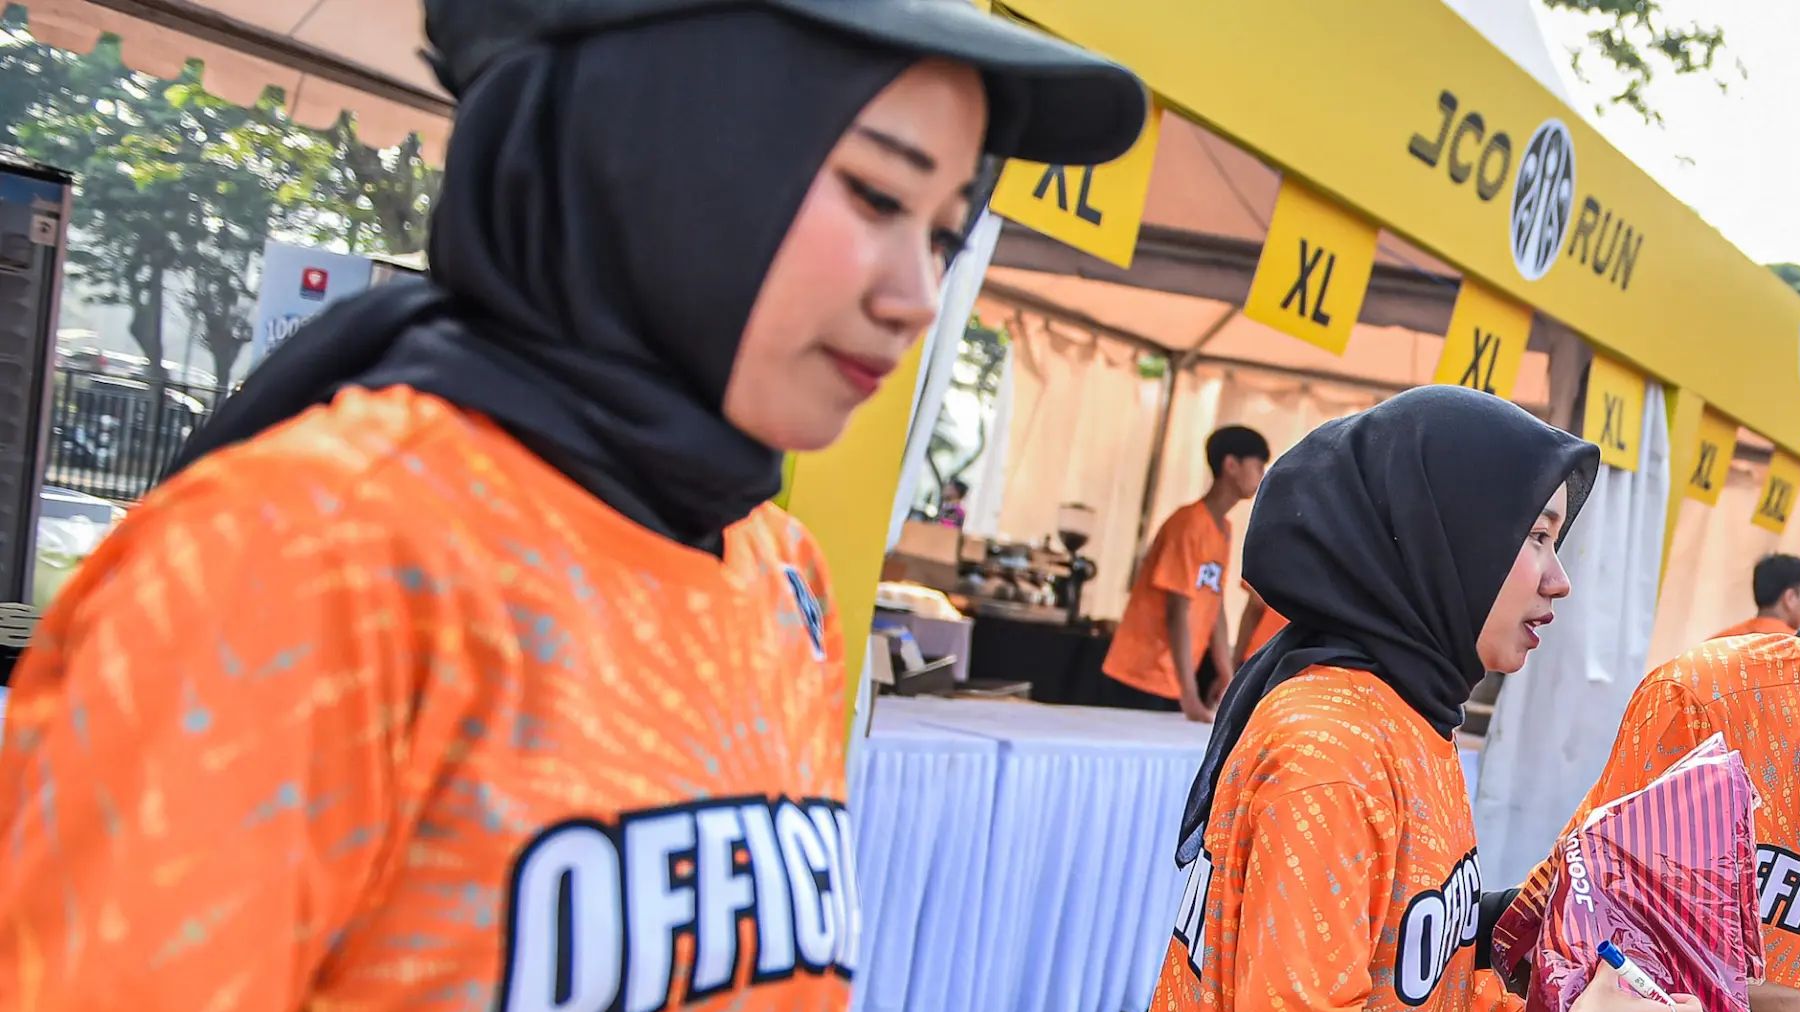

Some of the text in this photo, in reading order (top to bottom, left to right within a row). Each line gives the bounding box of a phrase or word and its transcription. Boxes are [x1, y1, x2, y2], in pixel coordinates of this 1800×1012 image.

[1407, 89, 1644, 292] JCO RUN
[1280, 236, 1336, 327] XL
[1459, 328, 1501, 394] XL
[1600, 391, 1626, 451] XL
